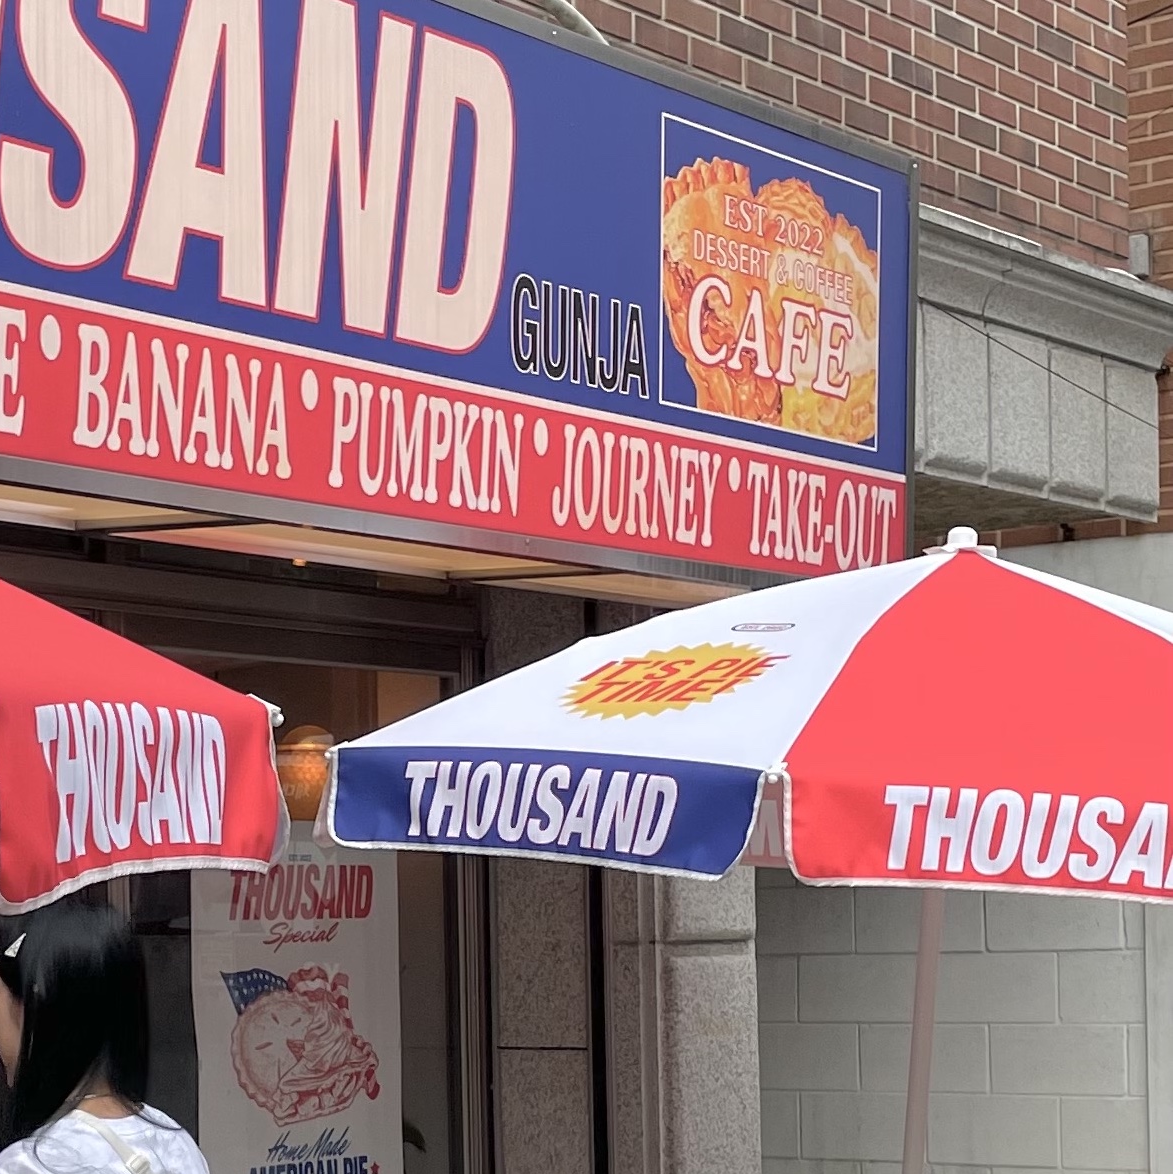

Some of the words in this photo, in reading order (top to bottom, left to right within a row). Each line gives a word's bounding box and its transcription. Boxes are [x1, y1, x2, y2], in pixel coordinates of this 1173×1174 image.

[692, 228, 771, 281] DESSERT
[775, 254, 789, 287] &
[792, 257, 854, 307] COFFEE
[723, 193, 769, 237] EST
[775, 215, 824, 257] 2022
[510, 272, 650, 400] GUNJA
[686, 275, 853, 401] CAFE
[72, 321, 293, 481] BANANA
[328, 377, 525, 520] PUMPKIN
[551, 423, 724, 549] JOURNEY
[747, 461, 897, 573] TAKE-OUT
[572, 678, 743, 704] TIME!
[578, 659, 696, 682] IT'S
[687, 654, 792, 681] PIE
[33, 698, 226, 865] THOUSAND
[405, 761, 680, 857] THOUSAND
[884, 784, 1173, 889] THOUSA
[229, 864, 374, 921] THOUSAND
[263, 922, 340, 953] Special
